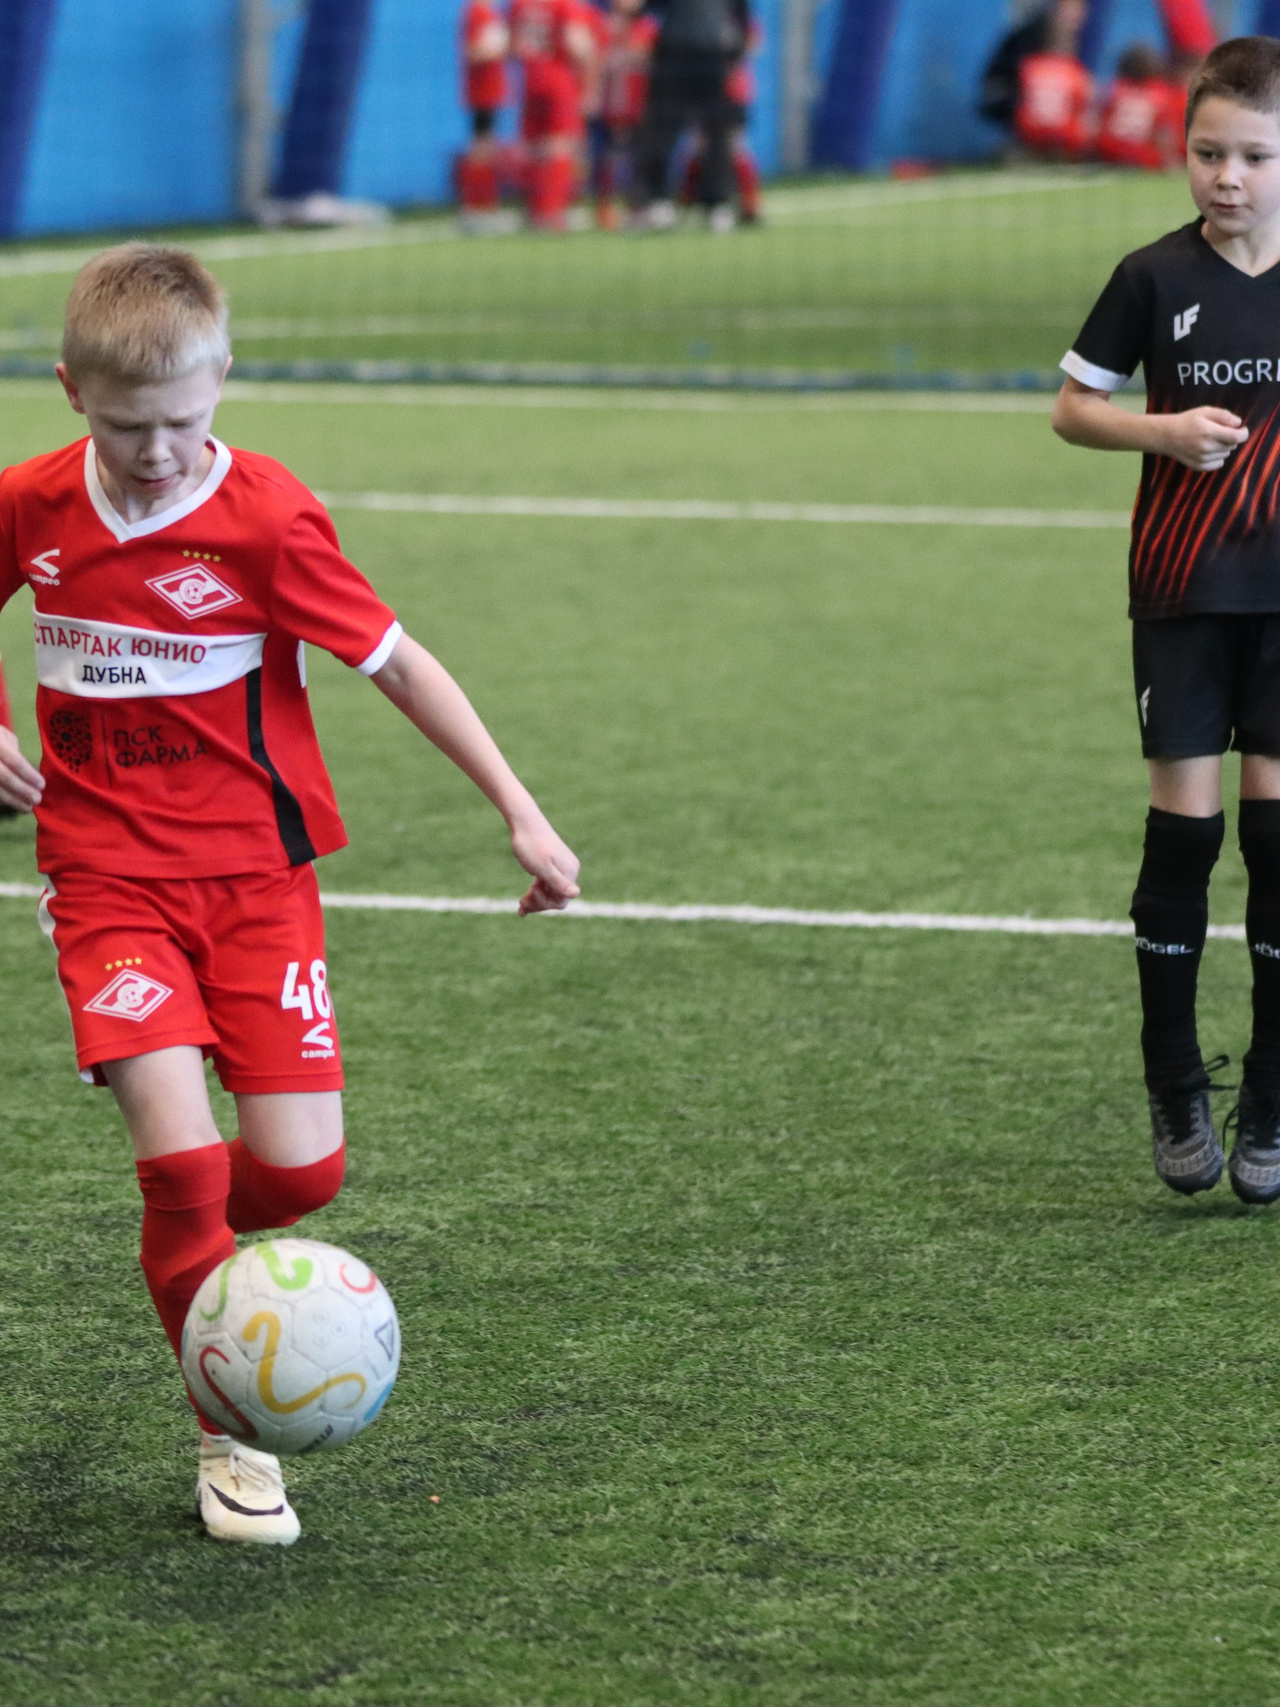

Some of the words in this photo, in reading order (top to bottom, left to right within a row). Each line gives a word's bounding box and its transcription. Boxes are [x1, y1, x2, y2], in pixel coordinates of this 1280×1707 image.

[1177, 358, 1280, 386] PROGR
[33, 622, 122, 658] СПАРТАК
[131, 637, 207, 664] ЮНИО
[81, 664, 147, 684] ДУБНА
[113, 725, 163, 748] ПСК
[115, 738, 208, 769] ФАРМА
[280, 958, 331, 1020] 48
